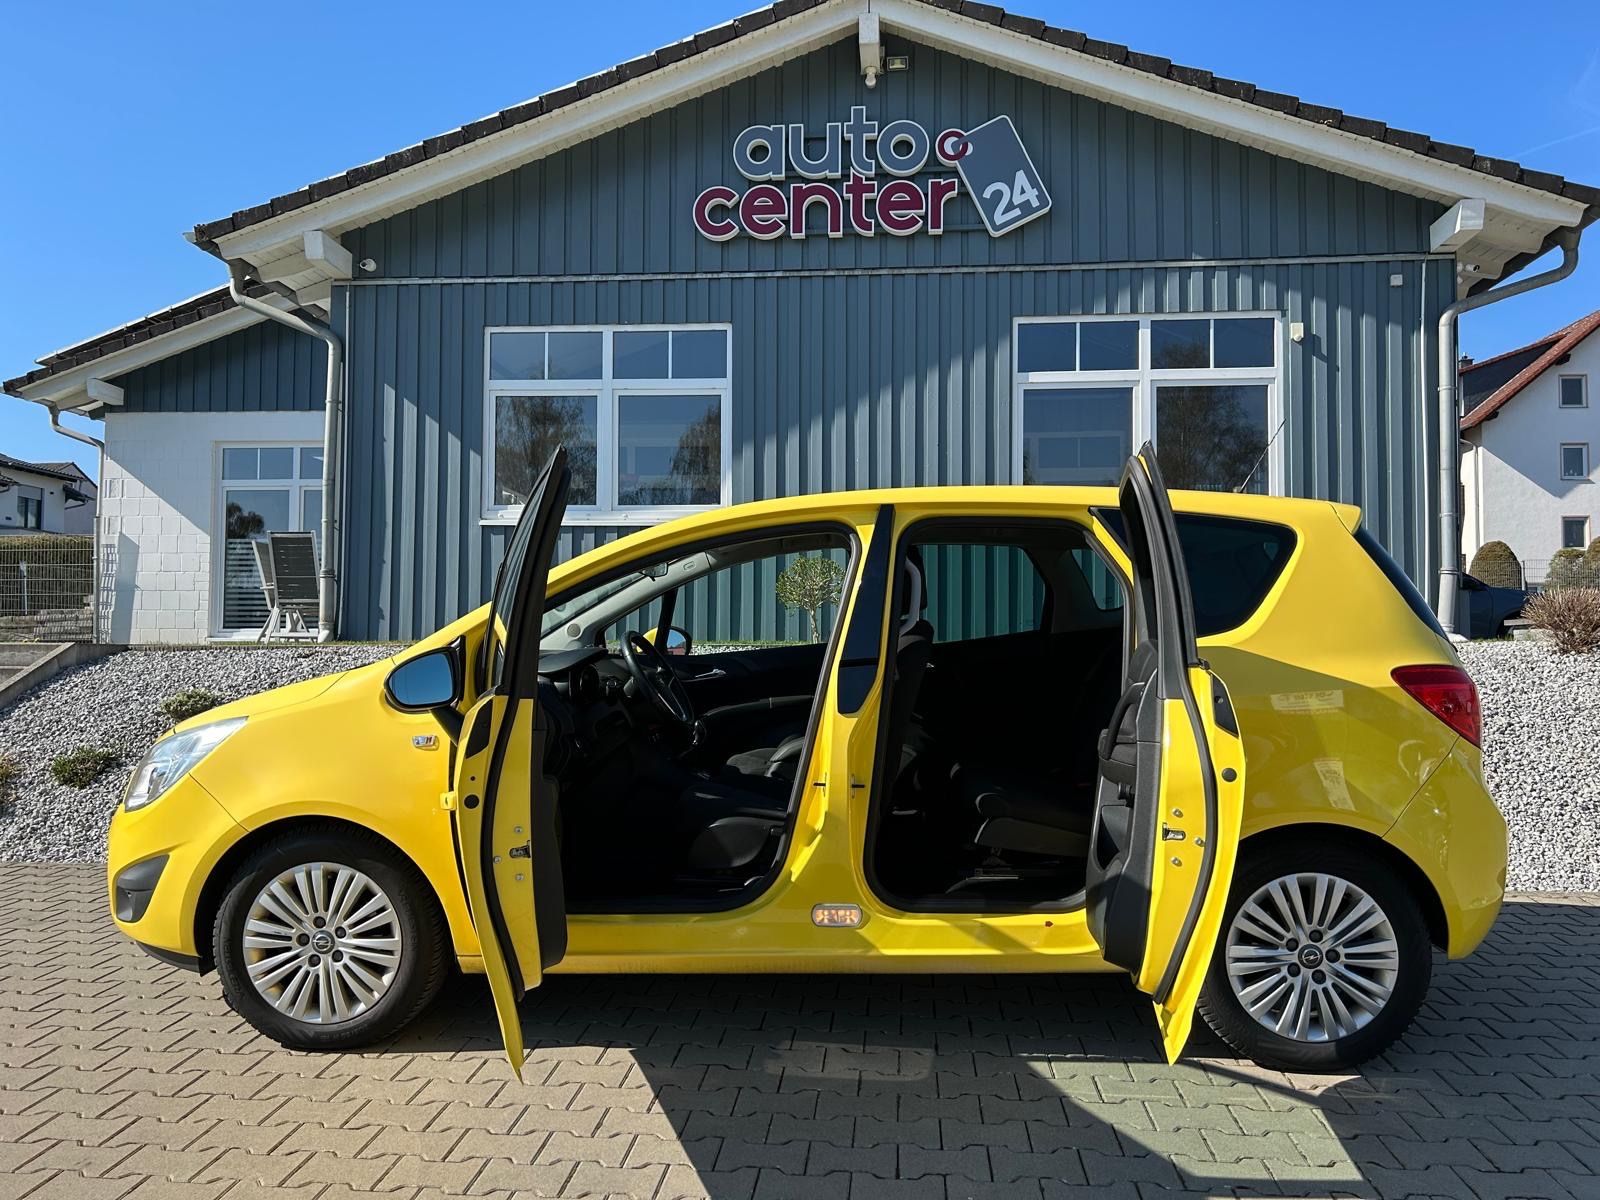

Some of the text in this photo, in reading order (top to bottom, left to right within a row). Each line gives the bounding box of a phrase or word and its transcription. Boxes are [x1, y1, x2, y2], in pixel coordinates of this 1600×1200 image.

[733, 105, 930, 181] auto
[693, 167, 958, 242] center
[982, 169, 1041, 226] 24
